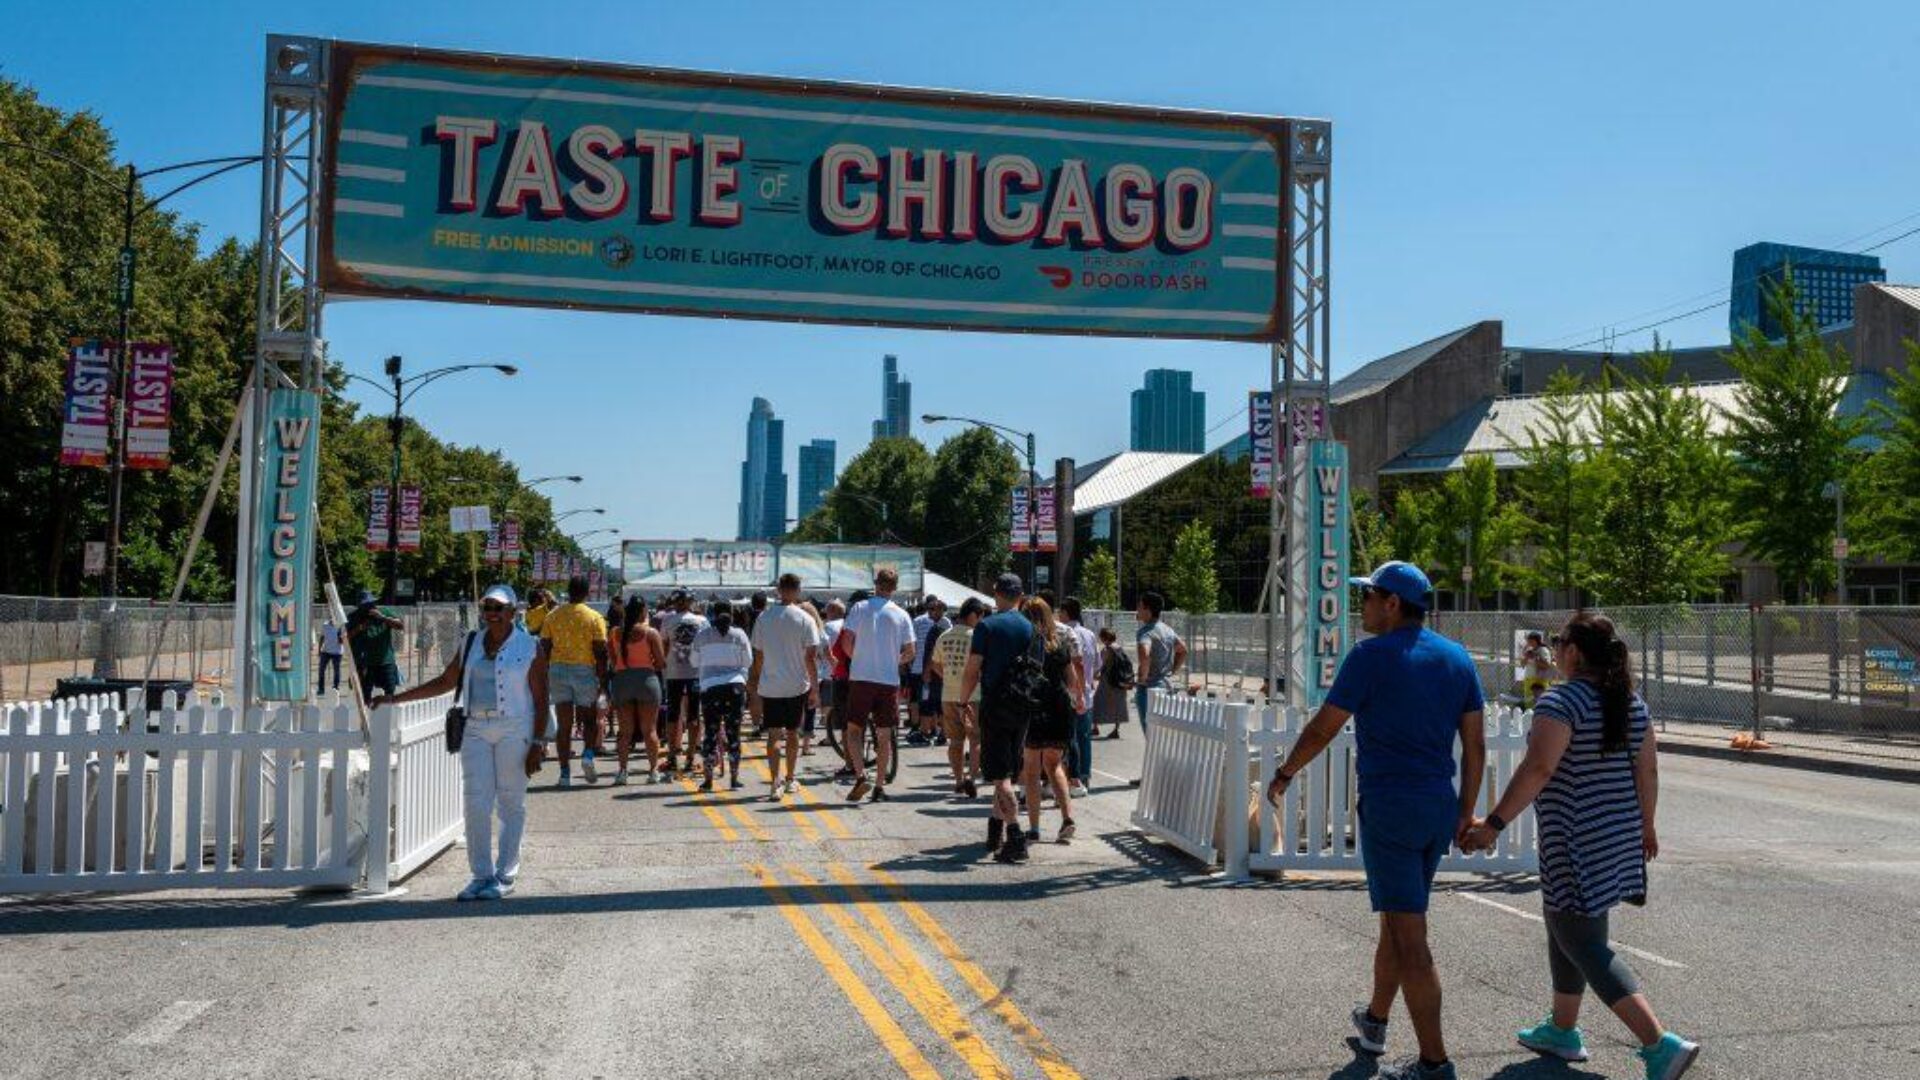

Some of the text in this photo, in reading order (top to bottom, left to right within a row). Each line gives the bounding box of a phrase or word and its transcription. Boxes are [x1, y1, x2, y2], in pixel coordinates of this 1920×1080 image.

[429, 116, 1214, 252] TASTE OF CHICAGO
[433, 229, 594, 256] FREE ADMISSION
[643, 246, 1000, 280] LORI E. LIGHTFOOT, MAYOR OF CHICAGO
[1082, 271, 1208, 290] DOORDASH
[71, 346, 109, 423] TASTE
[133, 350, 168, 427] TASTE
[369, 488, 389, 529] TASTE
[401, 489, 419, 529] TASTE
[269, 416, 310, 672] WELCOME
[648, 551, 768, 570] WELCOME
[1315, 465, 1343, 689] WELCOME
